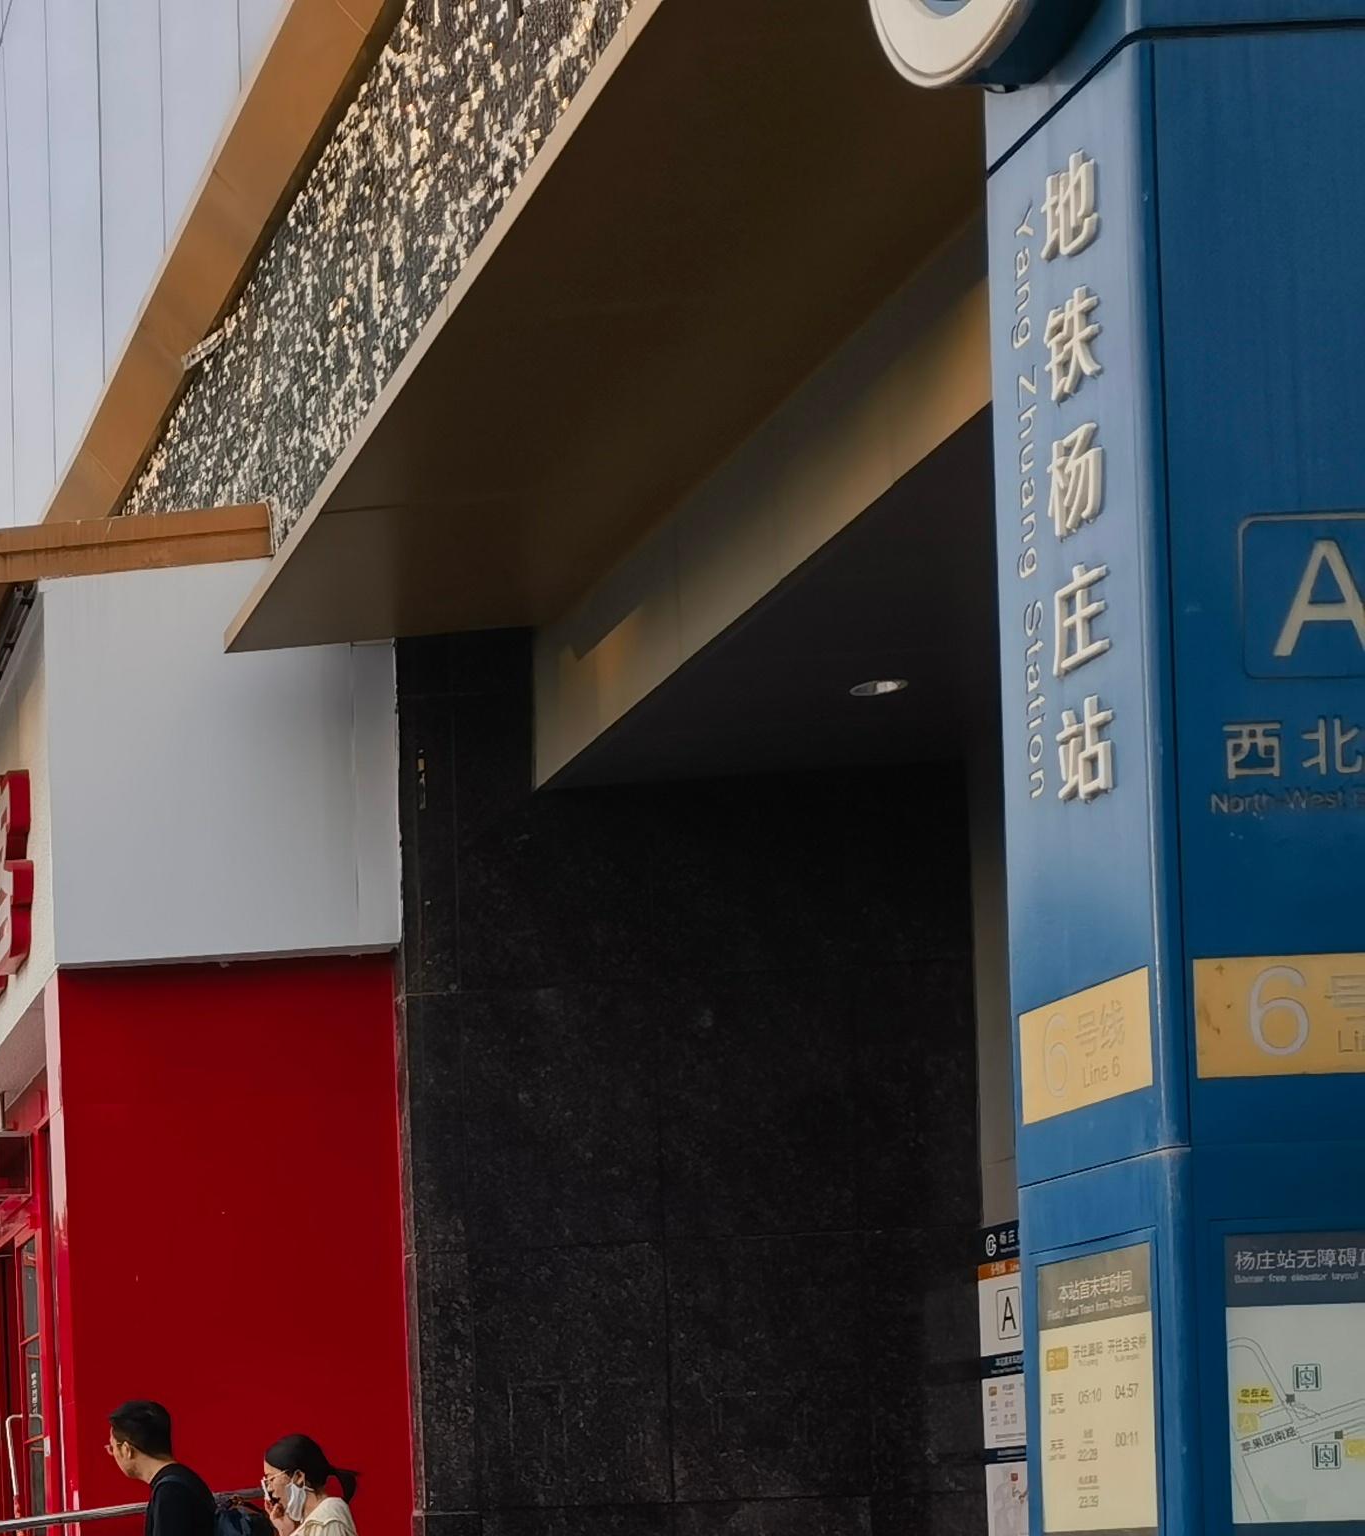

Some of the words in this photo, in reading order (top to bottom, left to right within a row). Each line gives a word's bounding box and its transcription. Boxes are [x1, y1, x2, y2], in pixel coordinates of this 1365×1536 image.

[1009, 200, 1037, 352] Yang
[1015, 364, 1039, 580] Zhuang
[1039, 147, 1116, 804] 地铁杨庄站
[1272, 538, 1365, 658] A
[1019, 599, 1048, 800] Station
[1082, 1064, 1110, 1089] Line
[1111, 1055, 1121, 1078] 6
[1000, 1295, 1018, 1333] A
[1057, 1269, 1133, 1304] 本站首末车时间
[1114, 1382, 1140, 1400] 04:57
